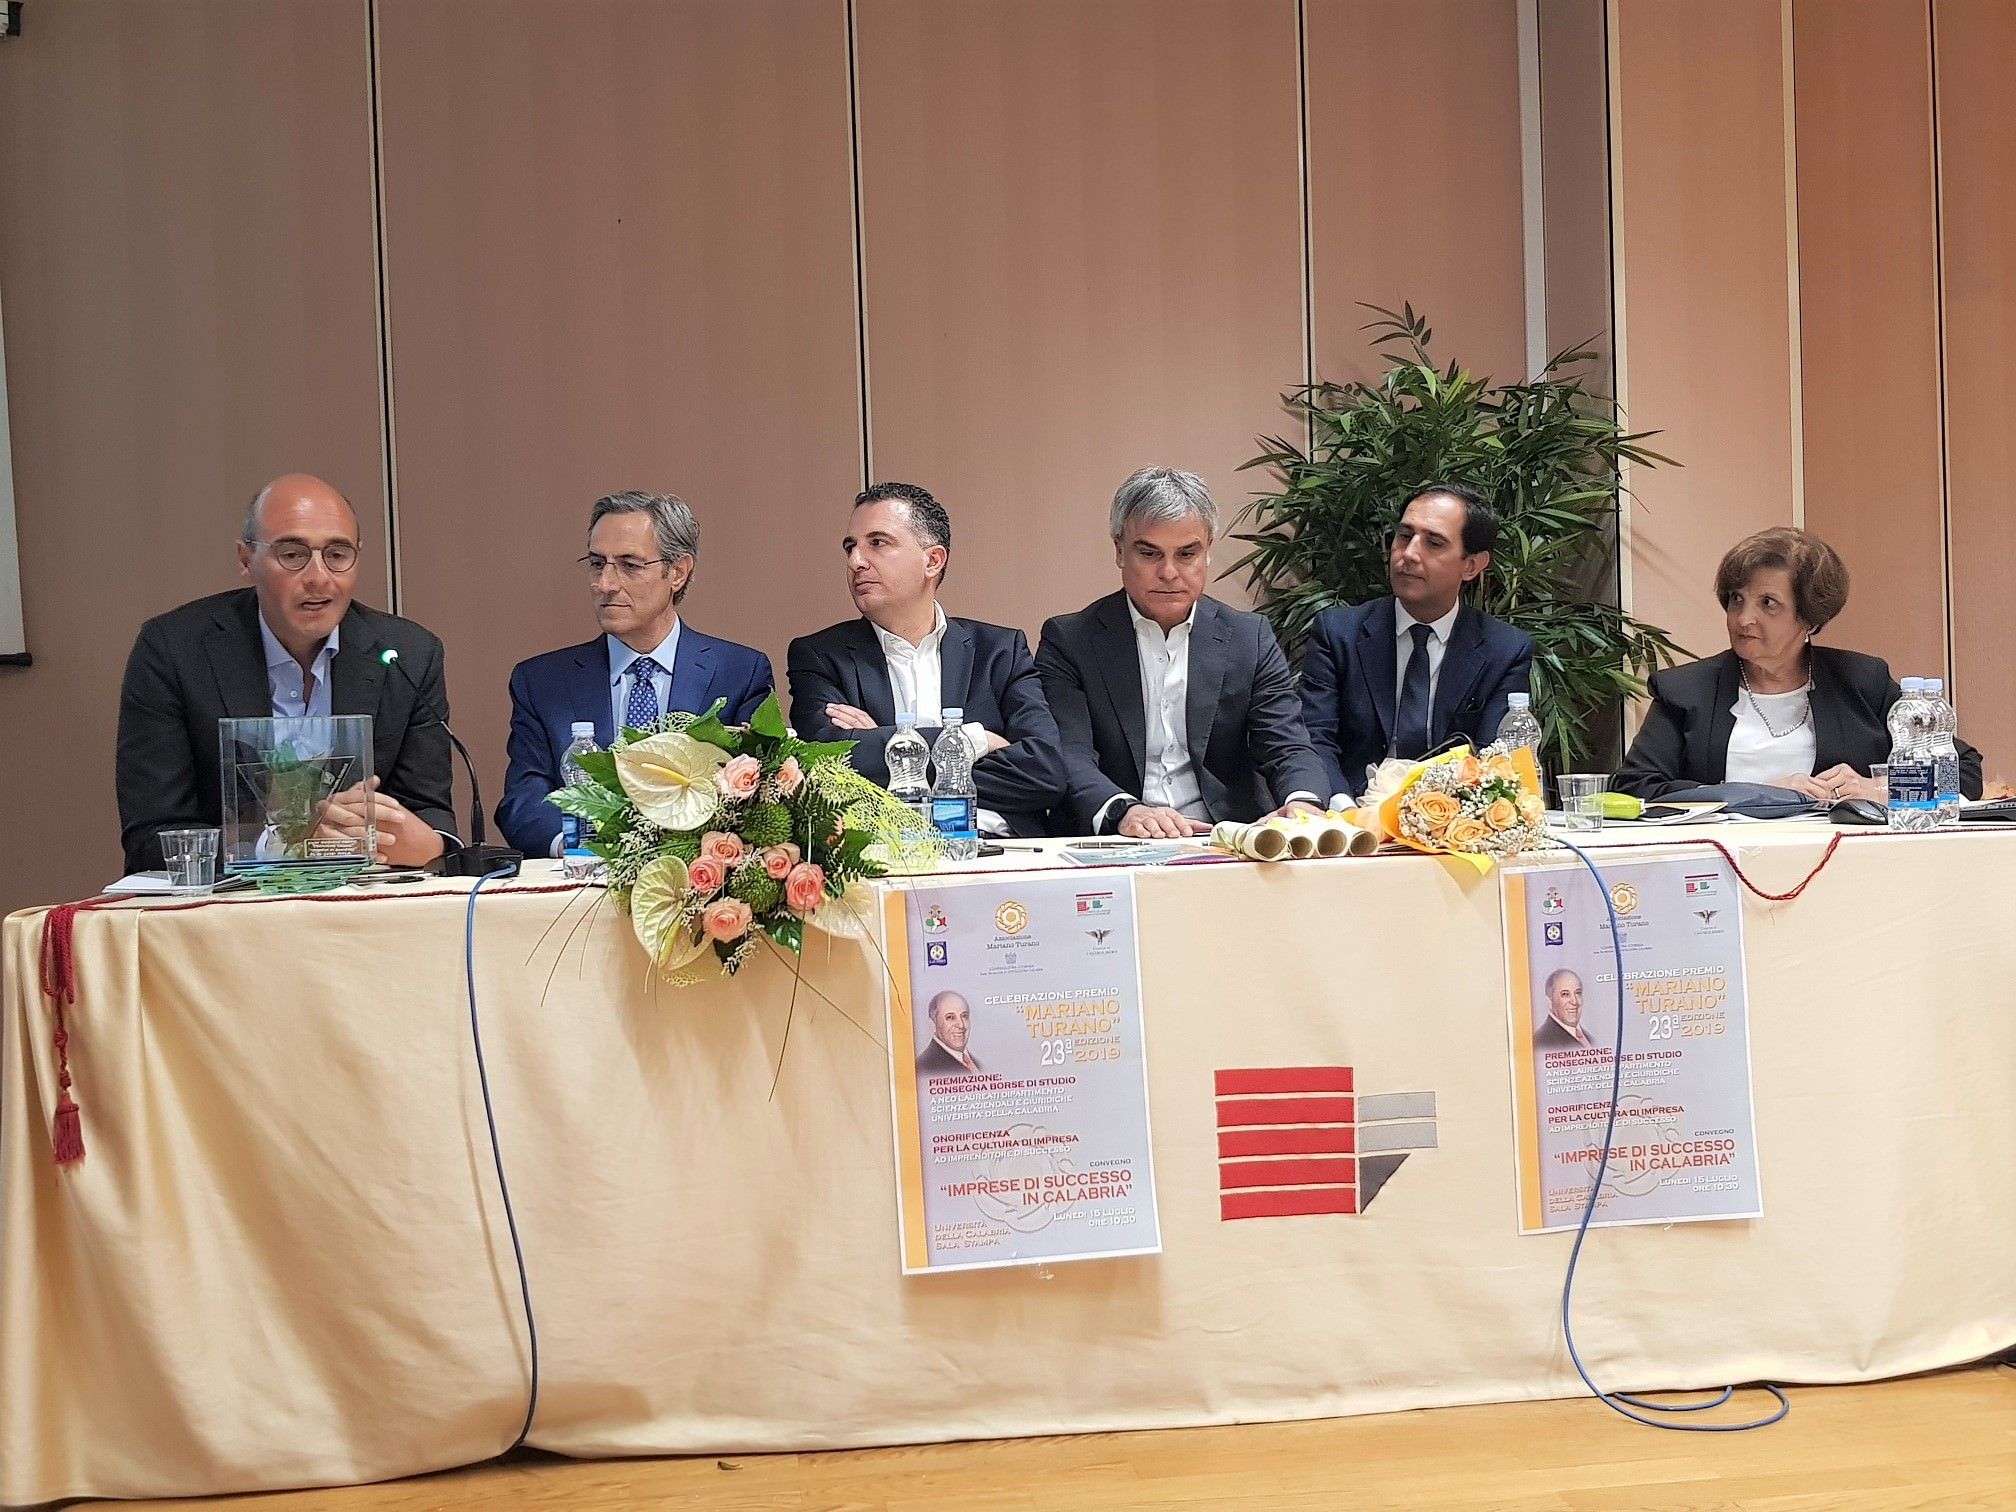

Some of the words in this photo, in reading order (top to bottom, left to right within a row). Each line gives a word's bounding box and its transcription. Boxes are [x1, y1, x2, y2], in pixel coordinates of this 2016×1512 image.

[986, 942, 1014, 950] Mariano
[1596, 968, 1680, 982] CELBRAZIONE
[1682, 965, 1724, 976] PREMIO
[984, 990, 1072, 1005] CELEBRAZIONE
[1075, 987, 1119, 998] PREMIO
[1681, 1012, 1726, 1022] EDIZIONE
[1681, 1023, 1726, 1038] 2019
[1074, 1036, 1120, 1046] EDIZIONE
[1075, 1048, 1120, 1062] 2019
[1545, 1047, 1612, 1060] PREMIAZIONE:
[1545, 1058, 1598, 1068] CONSEGNA
[1601, 1054, 1633, 1064] BOSE
[1635, 1052, 1646, 1061] DI
[1646, 1050, 1682, 1060] STUDIO
[1546, 1070, 1552, 1078] A
[1553, 1068, 1570, 1076] NEO
[1572, 1065, 1610, 1076] LAUREATI
[1546, 1076, 1580, 1086] SCIENZE
[1632, 1068, 1680, 1078] GIURIDICHE
[929, 1074, 1002, 1086] PREMIAZIONE:
[930, 1084, 989, 1095] CONSEGNA
[990, 1080, 1024, 1091] BORSE
[1027, 1079, 1038, 1088] DI
[1039, 1076, 1076, 1086] STUDIO
[1624, 1078, 1666, 1087] CALABRIA
[939, 1095, 956, 1104] NEO
[958, 1092, 1000, 1102] LAUREATI
[1002, 1087, 1064, 1098] DIPARTIMENTO
[932, 1103, 968, 1113] SCIENZE
[969, 1100, 1014, 1110] AZIENDALI
[1024, 1095, 1073, 1106] GIURIDICHE
[1548, 1101, 1618, 1114] ONORIFICENZ
[985, 1108, 1013, 1118] DELLA
[1014, 1106, 1059, 1115] CALABRIA
[1548, 1116, 1566, 1124] PER
[1569, 1114, 1582, 1122] LA
[1630, 1108, 1640, 1116] DI
[1641, 1106, 1684, 1116] IMPRESA
[1549, 1126, 1560, 1134] AD
[1632, 1116, 1676, 1126] SUCCESSO
[932, 1130, 1010, 1144] ONORIFICENZA
[1694, 1128, 1734, 1136] CONVEGNO
[934, 1145, 954, 1154] PER
[956, 1144, 970, 1152] LA
[972, 1140, 1020, 1151] CULTURA
[1022, 1138, 1032, 1146] DI
[1034, 1135, 1079, 1146] IMPRESA
[1632, 1145, 1646, 1158] DI
[1650, 1138, 1735, 1156] SUCCESSO
[934, 1156, 947, 1164] AD
[948, 1150, 1014, 1163] IMPRENDITORE
[1024, 1146, 1070, 1156] SUCCESSO
[1090, 1159, 1132, 1167] CONVEGNO
[1630, 1160, 1646, 1172] IN
[1024, 1178, 1040, 1190] DI
[1044, 1170, 1132, 1188] SUCCESSO
[1707, 1174, 1738, 1182] LUGLIO
[1022, 1192, 1039, 1205] IN
[1102, 1207, 1135, 1216] LUGLIO
[1549, 1204, 1572, 1213] SALA
[1088, 1218, 1108, 1226] ORE
[936, 1232, 964, 1242] DELLA
[966, 1228, 1011, 1238] CALABRIA
[936, 1242, 960, 1250] SALA
[964, 1239, 1000, 1248] STAMPA
